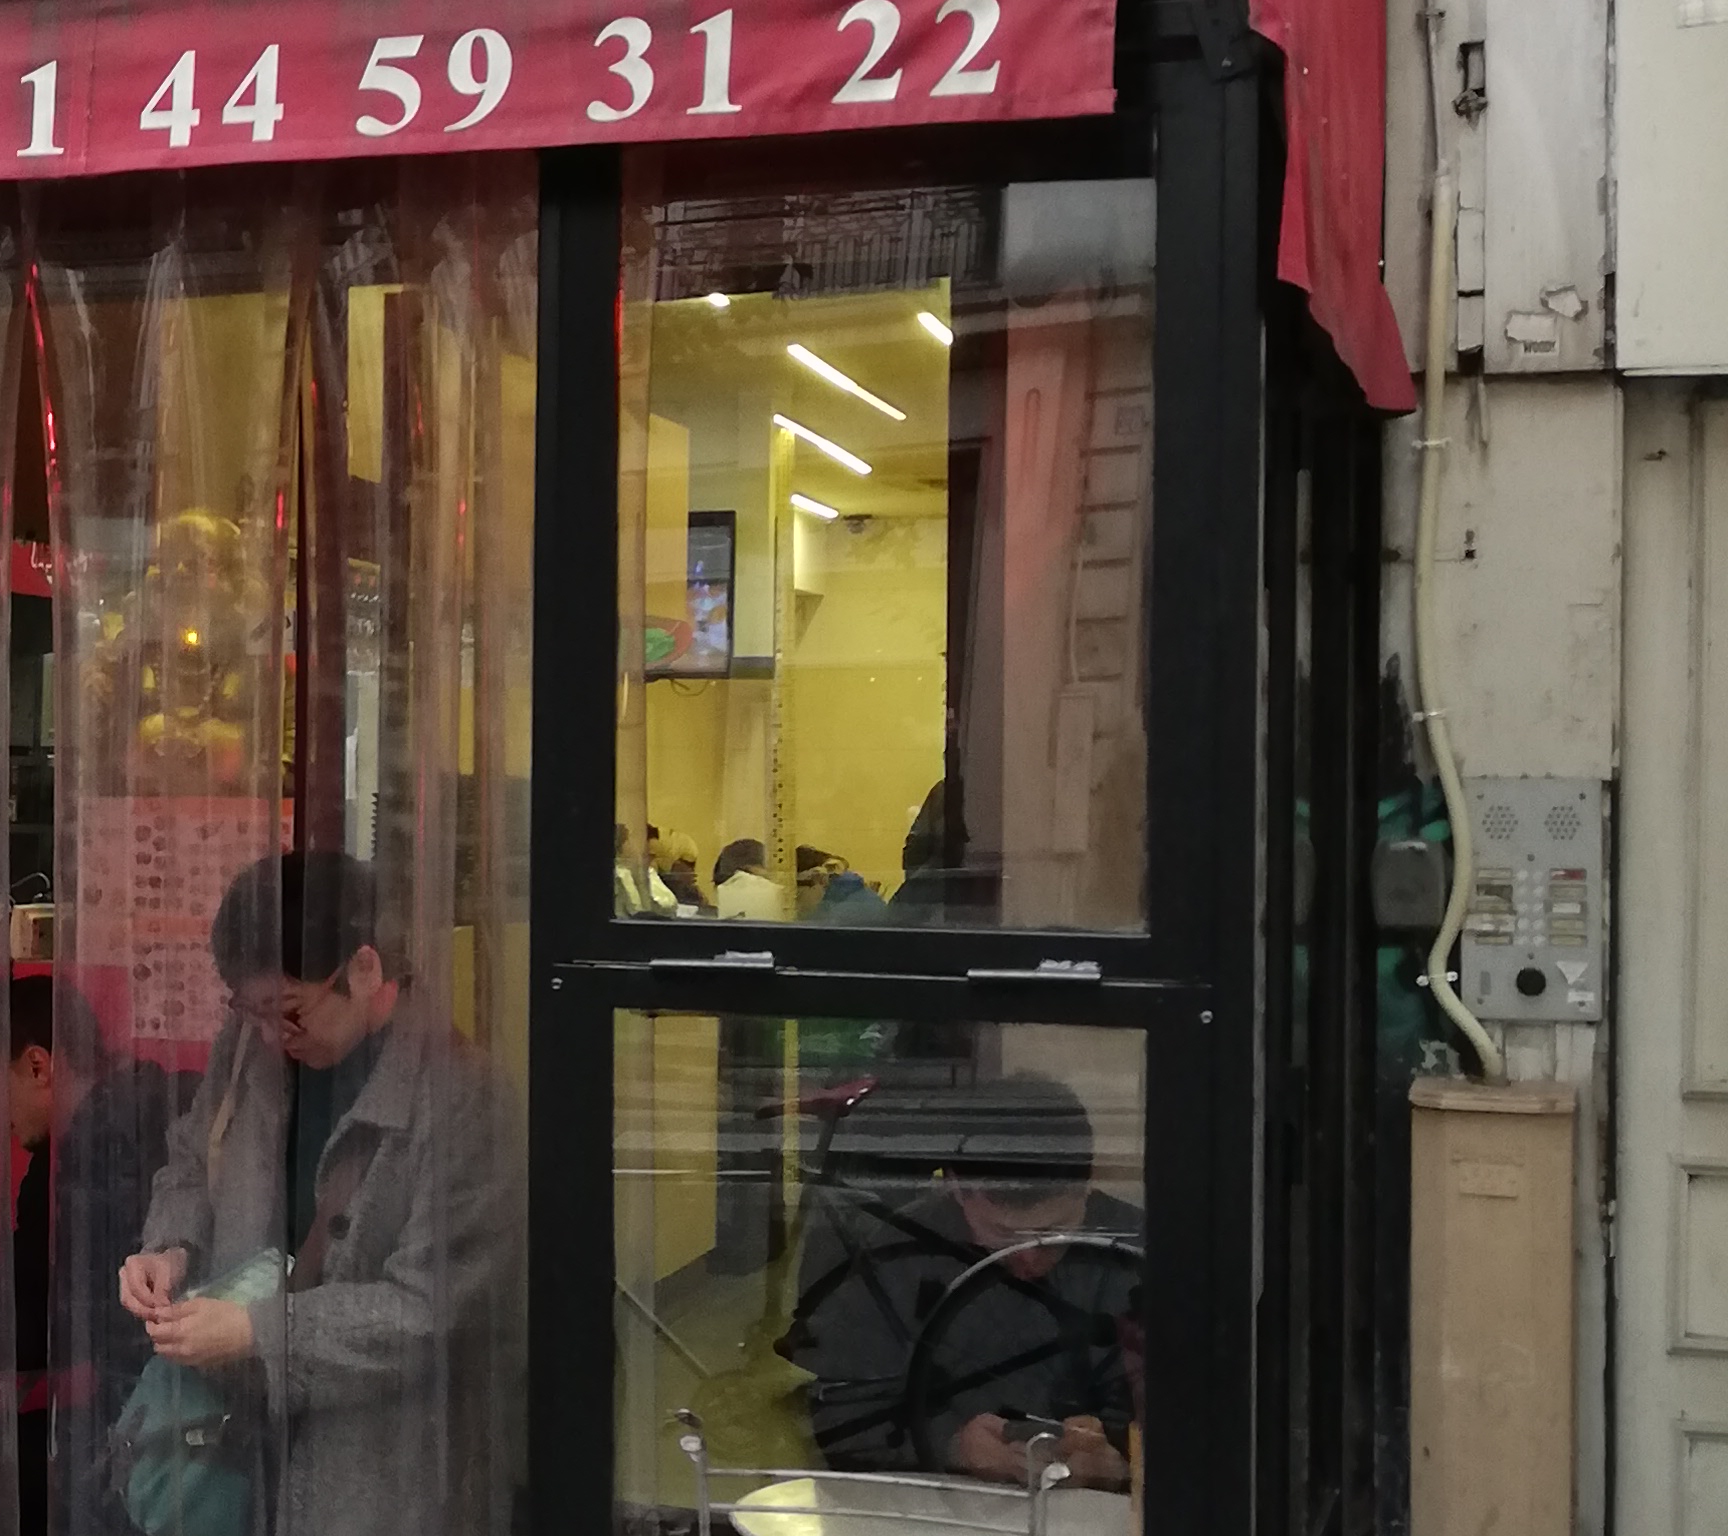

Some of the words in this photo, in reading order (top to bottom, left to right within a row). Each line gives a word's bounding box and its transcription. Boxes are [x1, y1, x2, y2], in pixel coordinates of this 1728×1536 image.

[139, 44, 284, 149] 44
[355, 29, 513, 138] 59
[586, 9, 743, 123] 31
